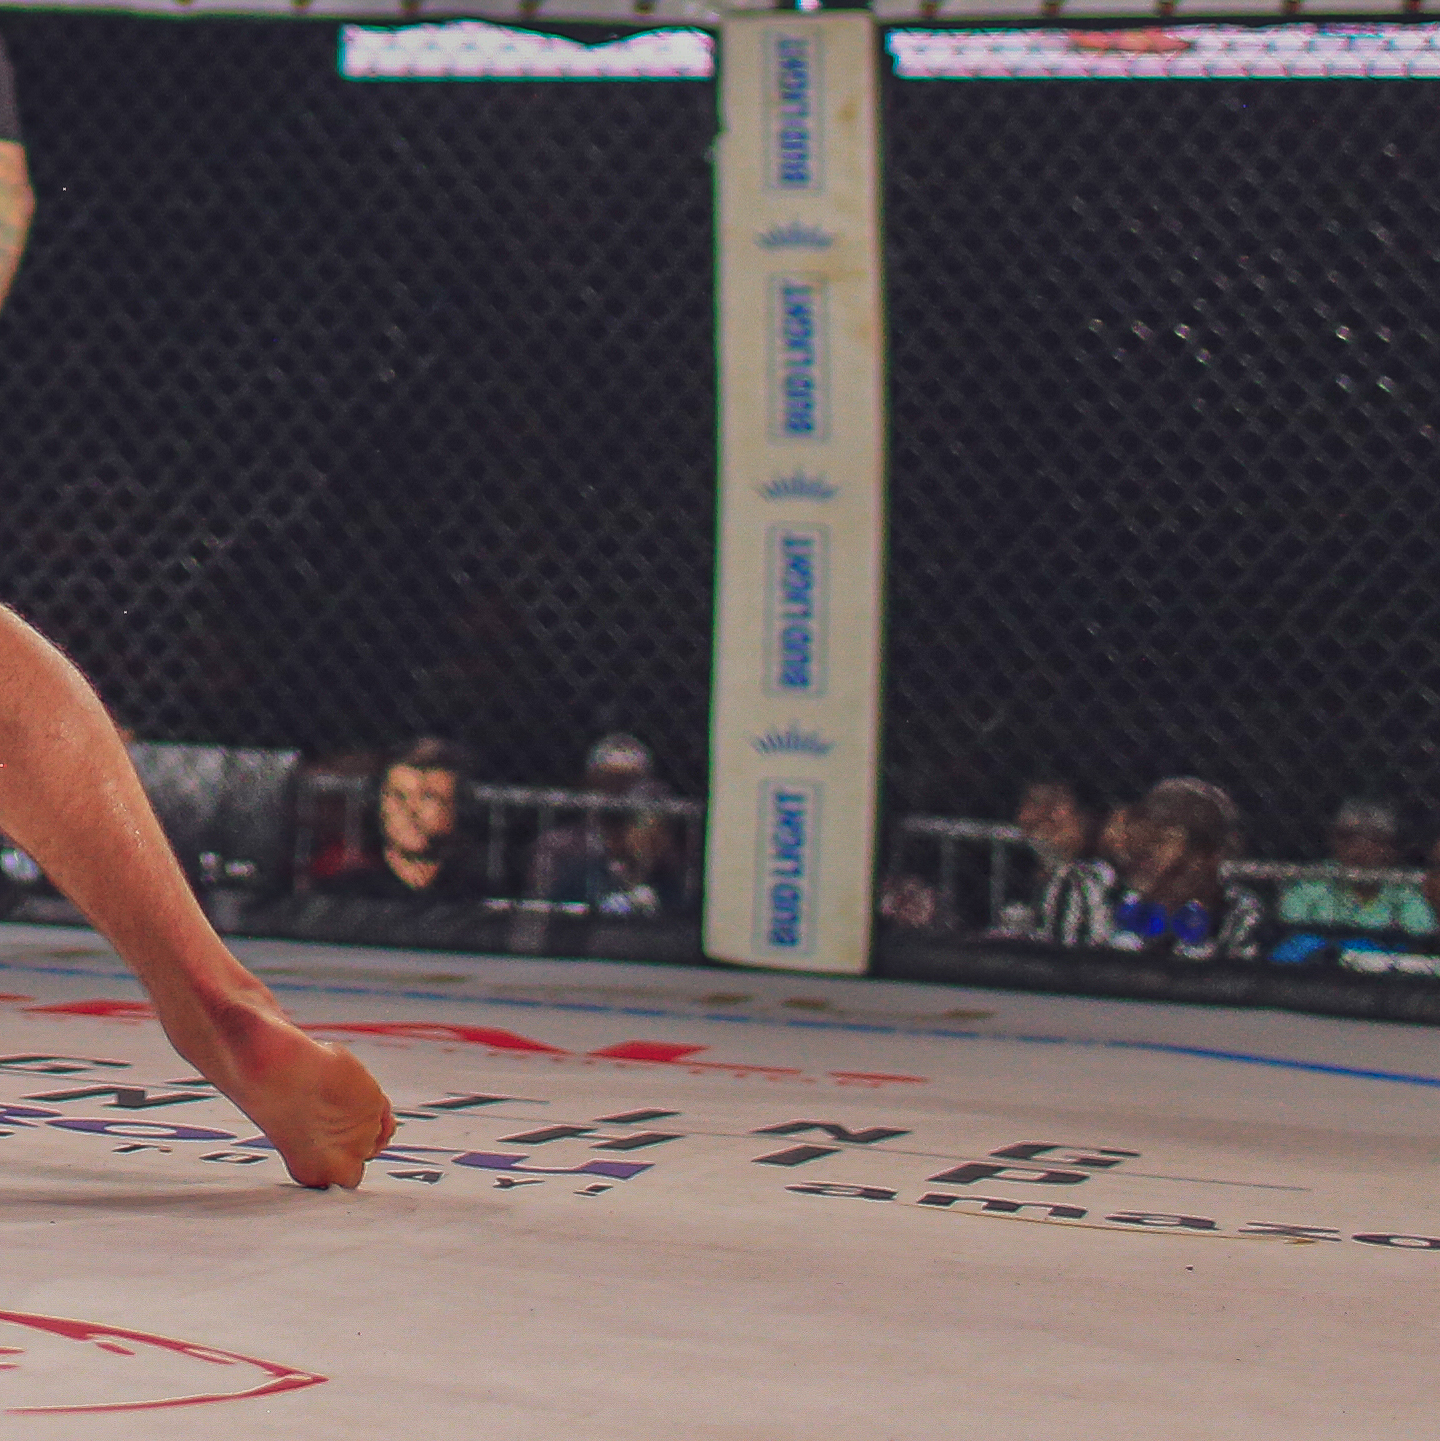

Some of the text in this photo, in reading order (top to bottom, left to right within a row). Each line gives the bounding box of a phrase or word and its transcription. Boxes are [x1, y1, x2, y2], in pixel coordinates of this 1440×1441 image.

[782, 375, 815, 435] BUD
[778, 536, 814, 689] BUD LIGHT
[767, 790, 806, 949] BUD LIGHT
[110, 1142, 616, 1198] TOAY!
